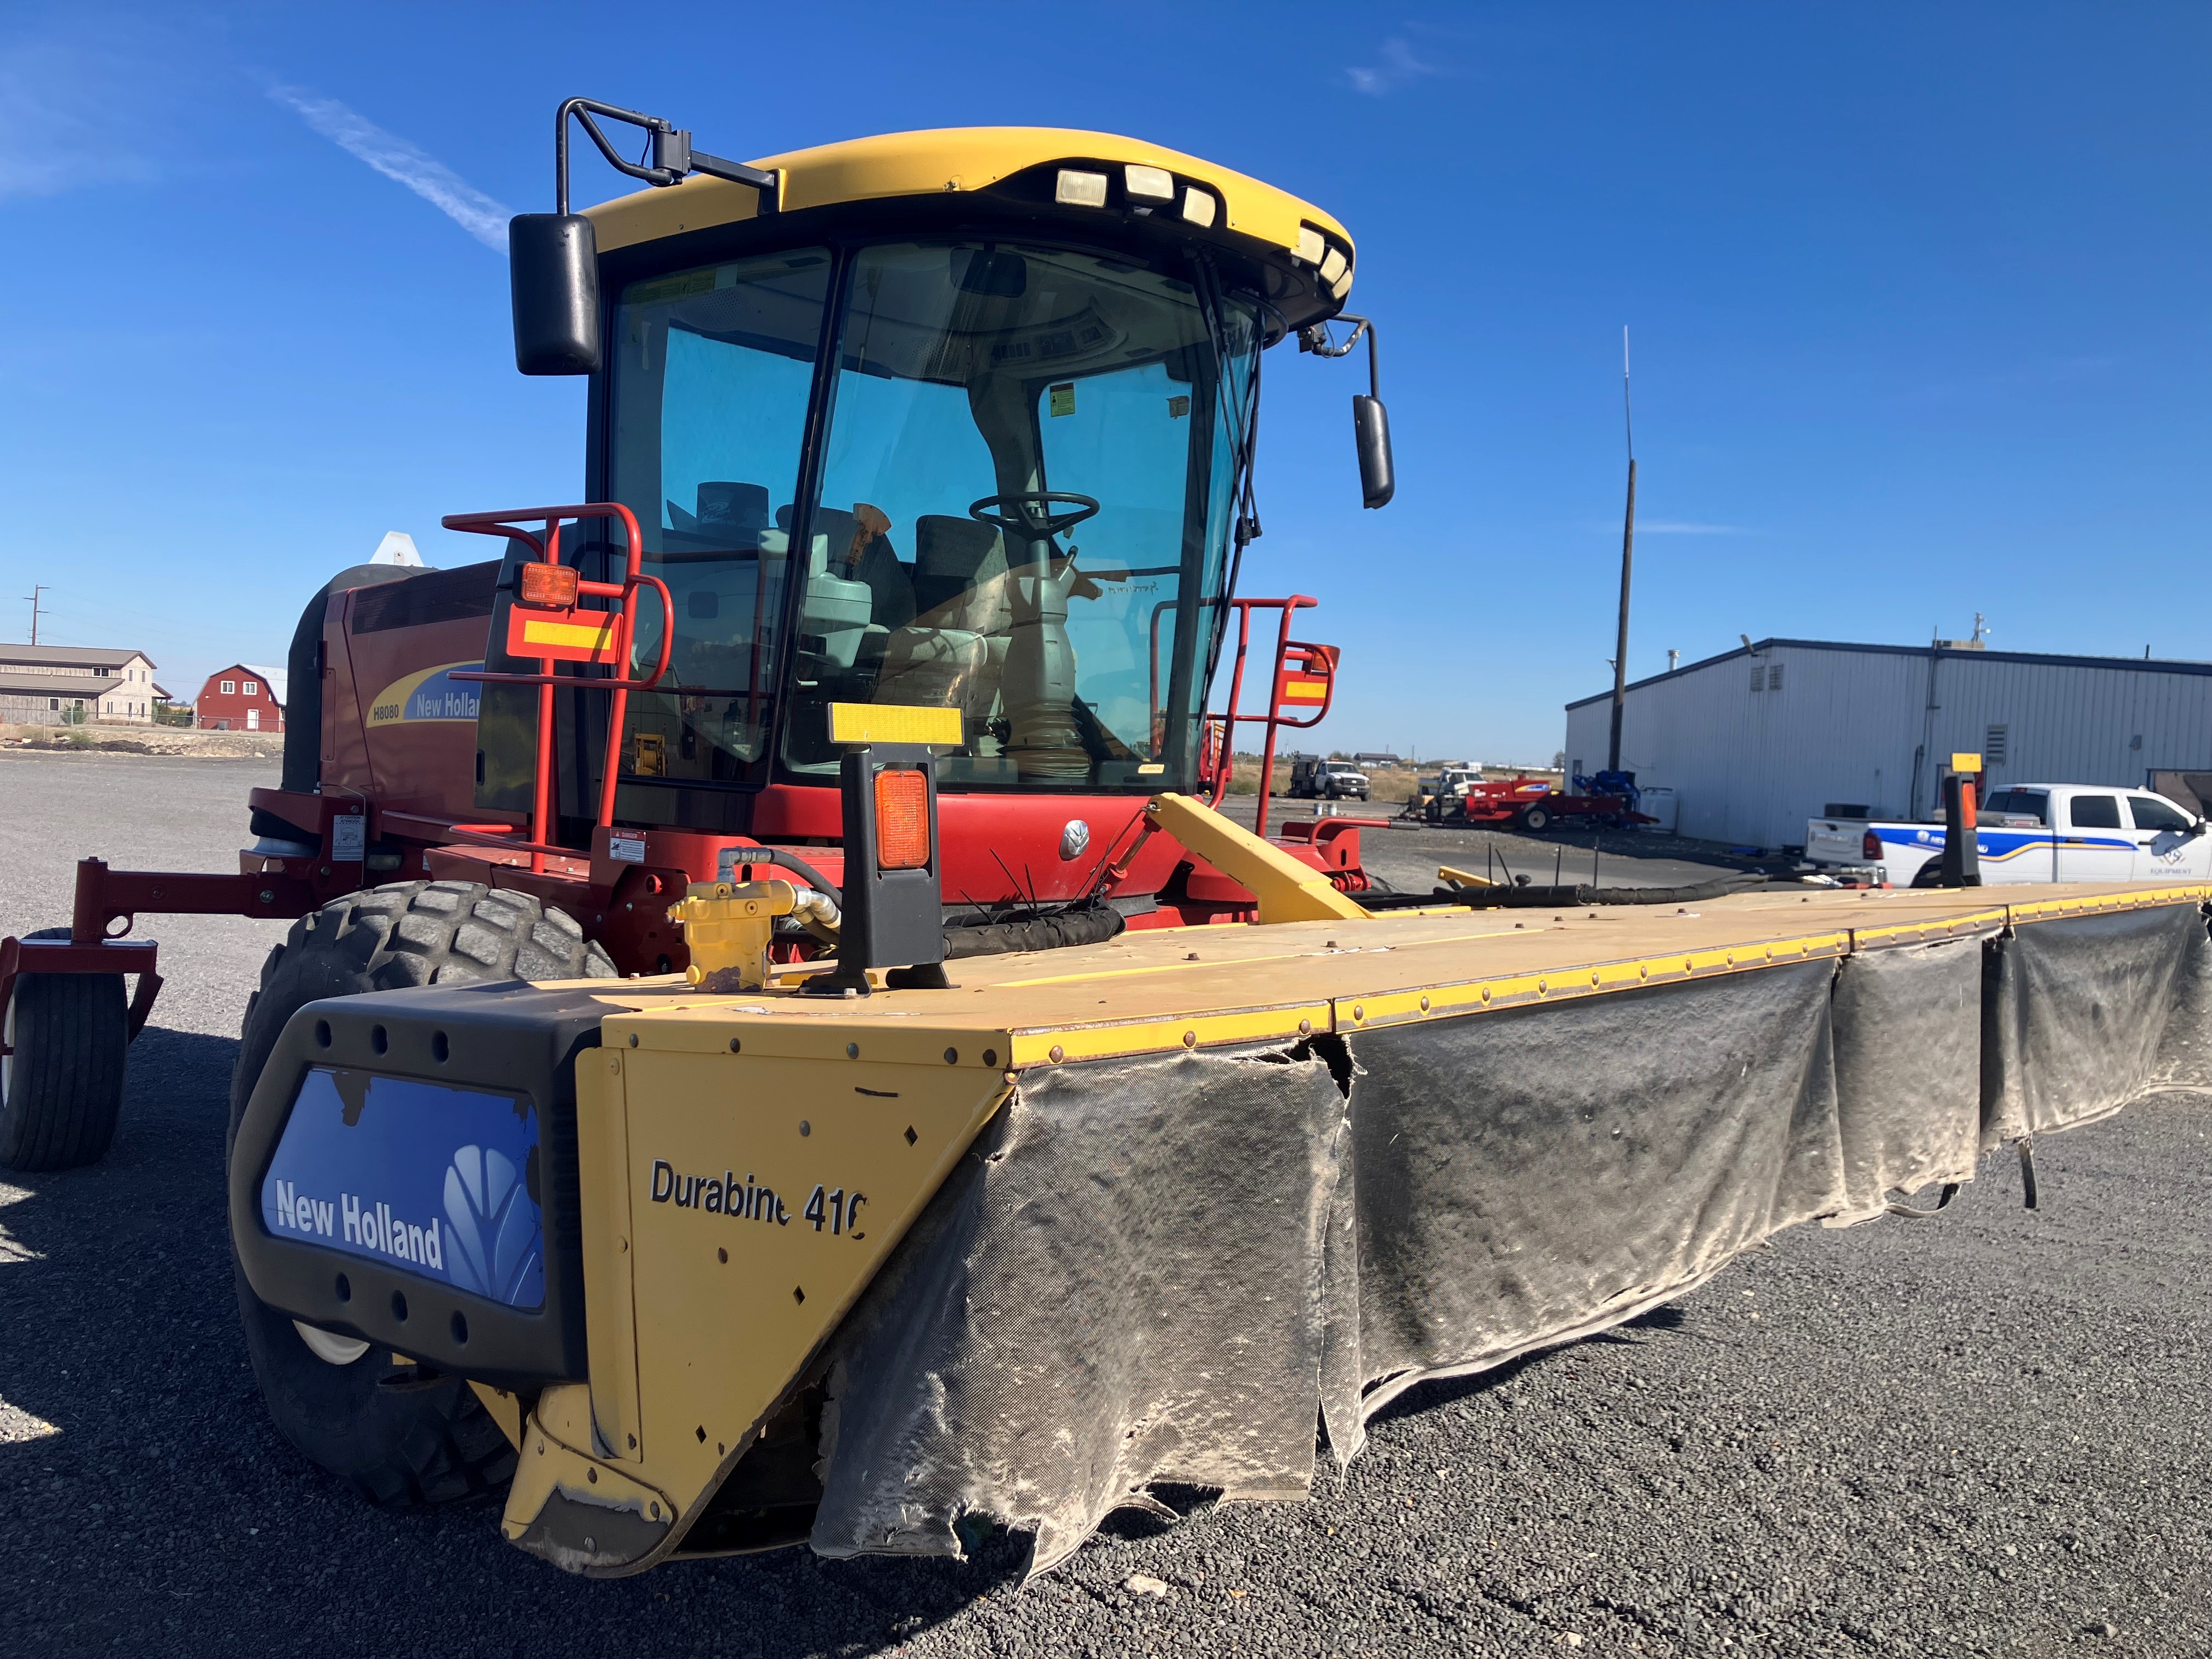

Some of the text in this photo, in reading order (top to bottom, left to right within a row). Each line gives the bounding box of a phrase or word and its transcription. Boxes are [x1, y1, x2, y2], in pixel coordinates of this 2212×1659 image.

[374, 704, 399, 720] H8080
[416, 692, 479, 717] New Holla
[275, 1178, 443, 1271] New Holland
